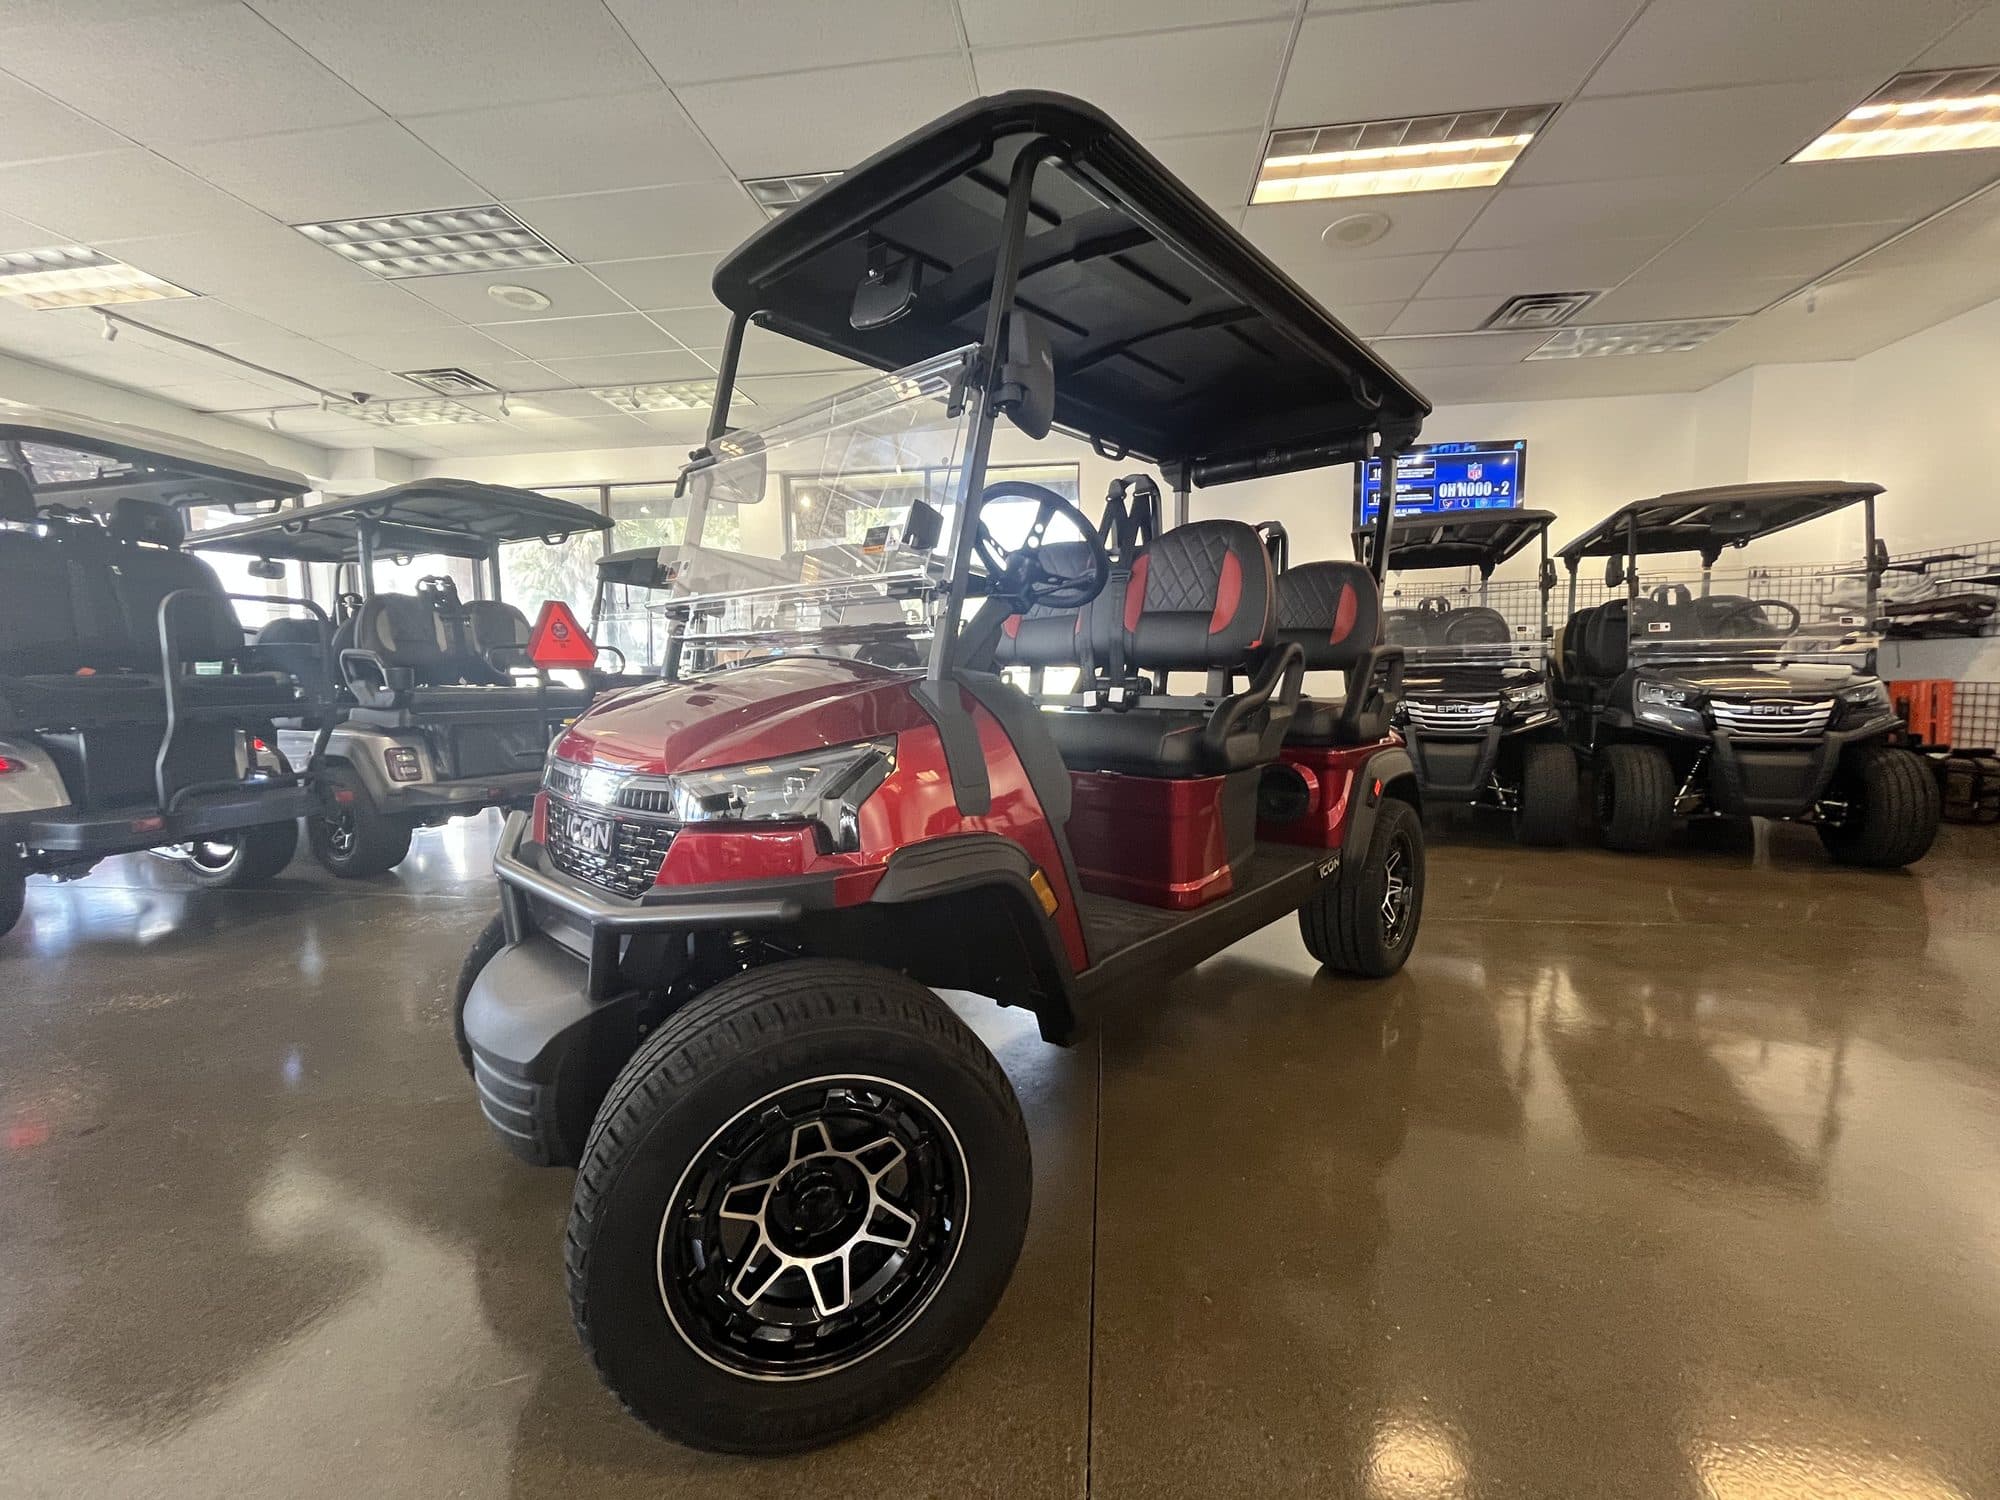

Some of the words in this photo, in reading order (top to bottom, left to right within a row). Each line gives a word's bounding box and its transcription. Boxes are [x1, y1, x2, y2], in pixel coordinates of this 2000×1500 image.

[1500, 480, 1510, 496] 2
[1437, 705, 1467, 713] EPIC
[1752, 705, 1792, 715] EPIC
[566, 814, 610, 850] ICON
[1320, 857, 1340, 879] ICON
